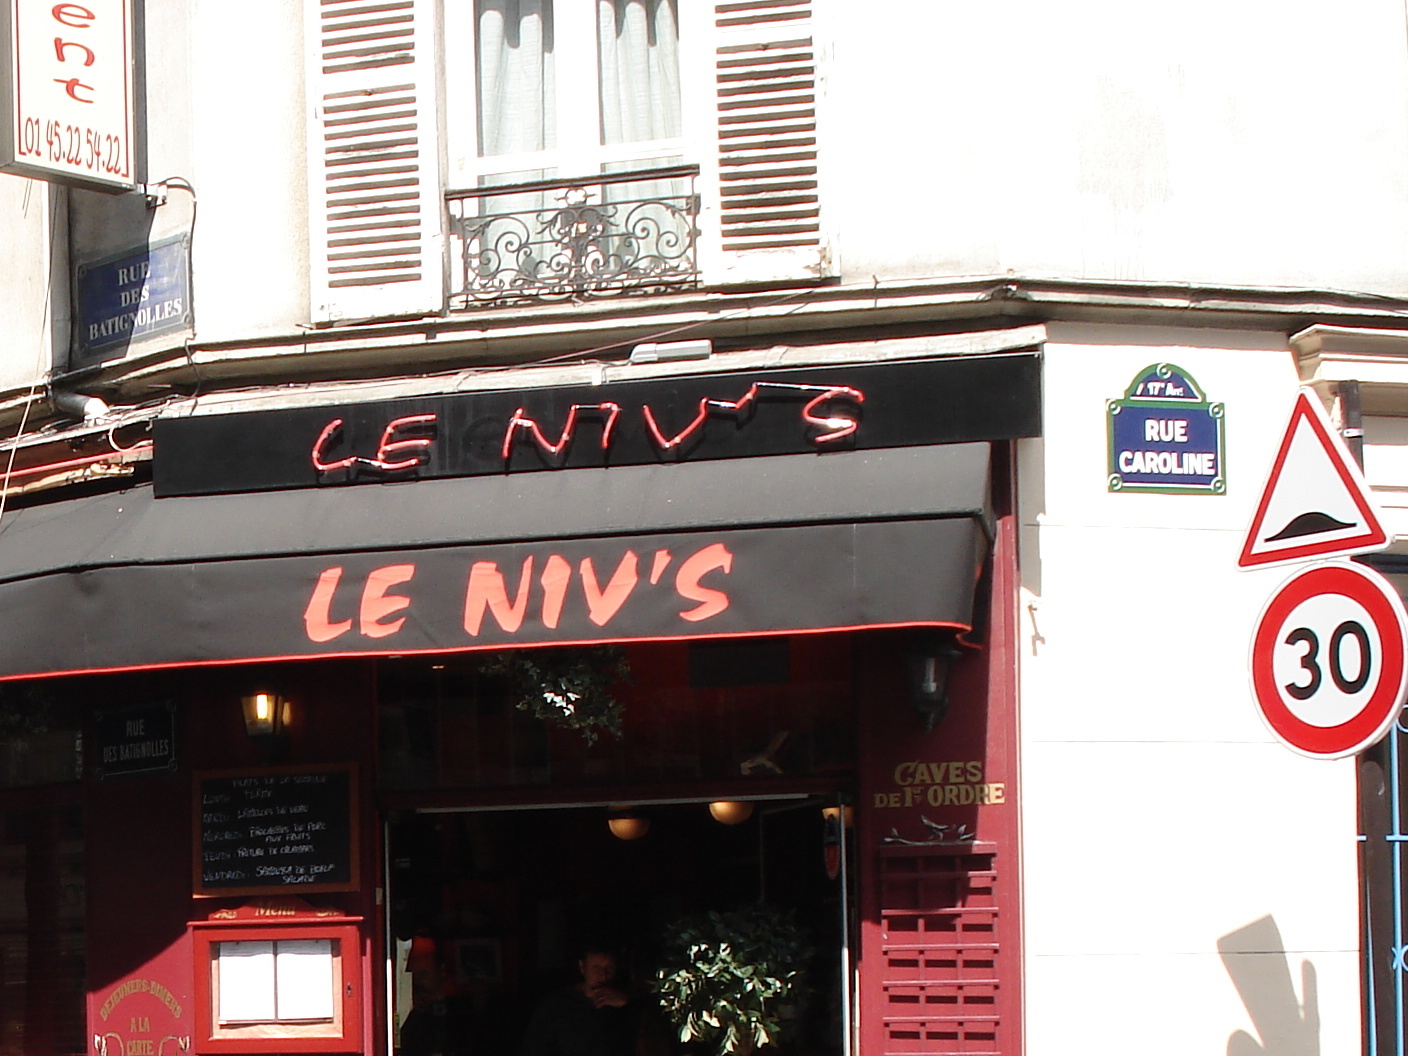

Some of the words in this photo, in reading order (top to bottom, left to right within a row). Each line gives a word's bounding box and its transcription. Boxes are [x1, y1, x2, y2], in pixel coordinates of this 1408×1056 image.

[119, 262, 151, 286] RUE
[121, 286, 150, 307] DES
[89, 298, 182, 341] BATIGNOLLES
[1145, 418, 1188, 442] RUE
[312, 413, 436, 472] LE
[1119, 450, 1216, 476] CAROLINE
[303, 562, 415, 642] LE
[463, 542, 733, 637] NIV'S
[1284, 620, 1372, 701] 30
[126, 718, 144, 737] RUE
[103, 745, 117, 763] DES
[120, 739, 169, 761] BATIGNOLLES
[894, 760, 982, 785] CAVES
[874, 793, 901, 808] DE
[927, 783, 1005, 807] ORDRE
[255, 902, 296, 917] Menu
[126, 1040, 154, 1056] CARTE
